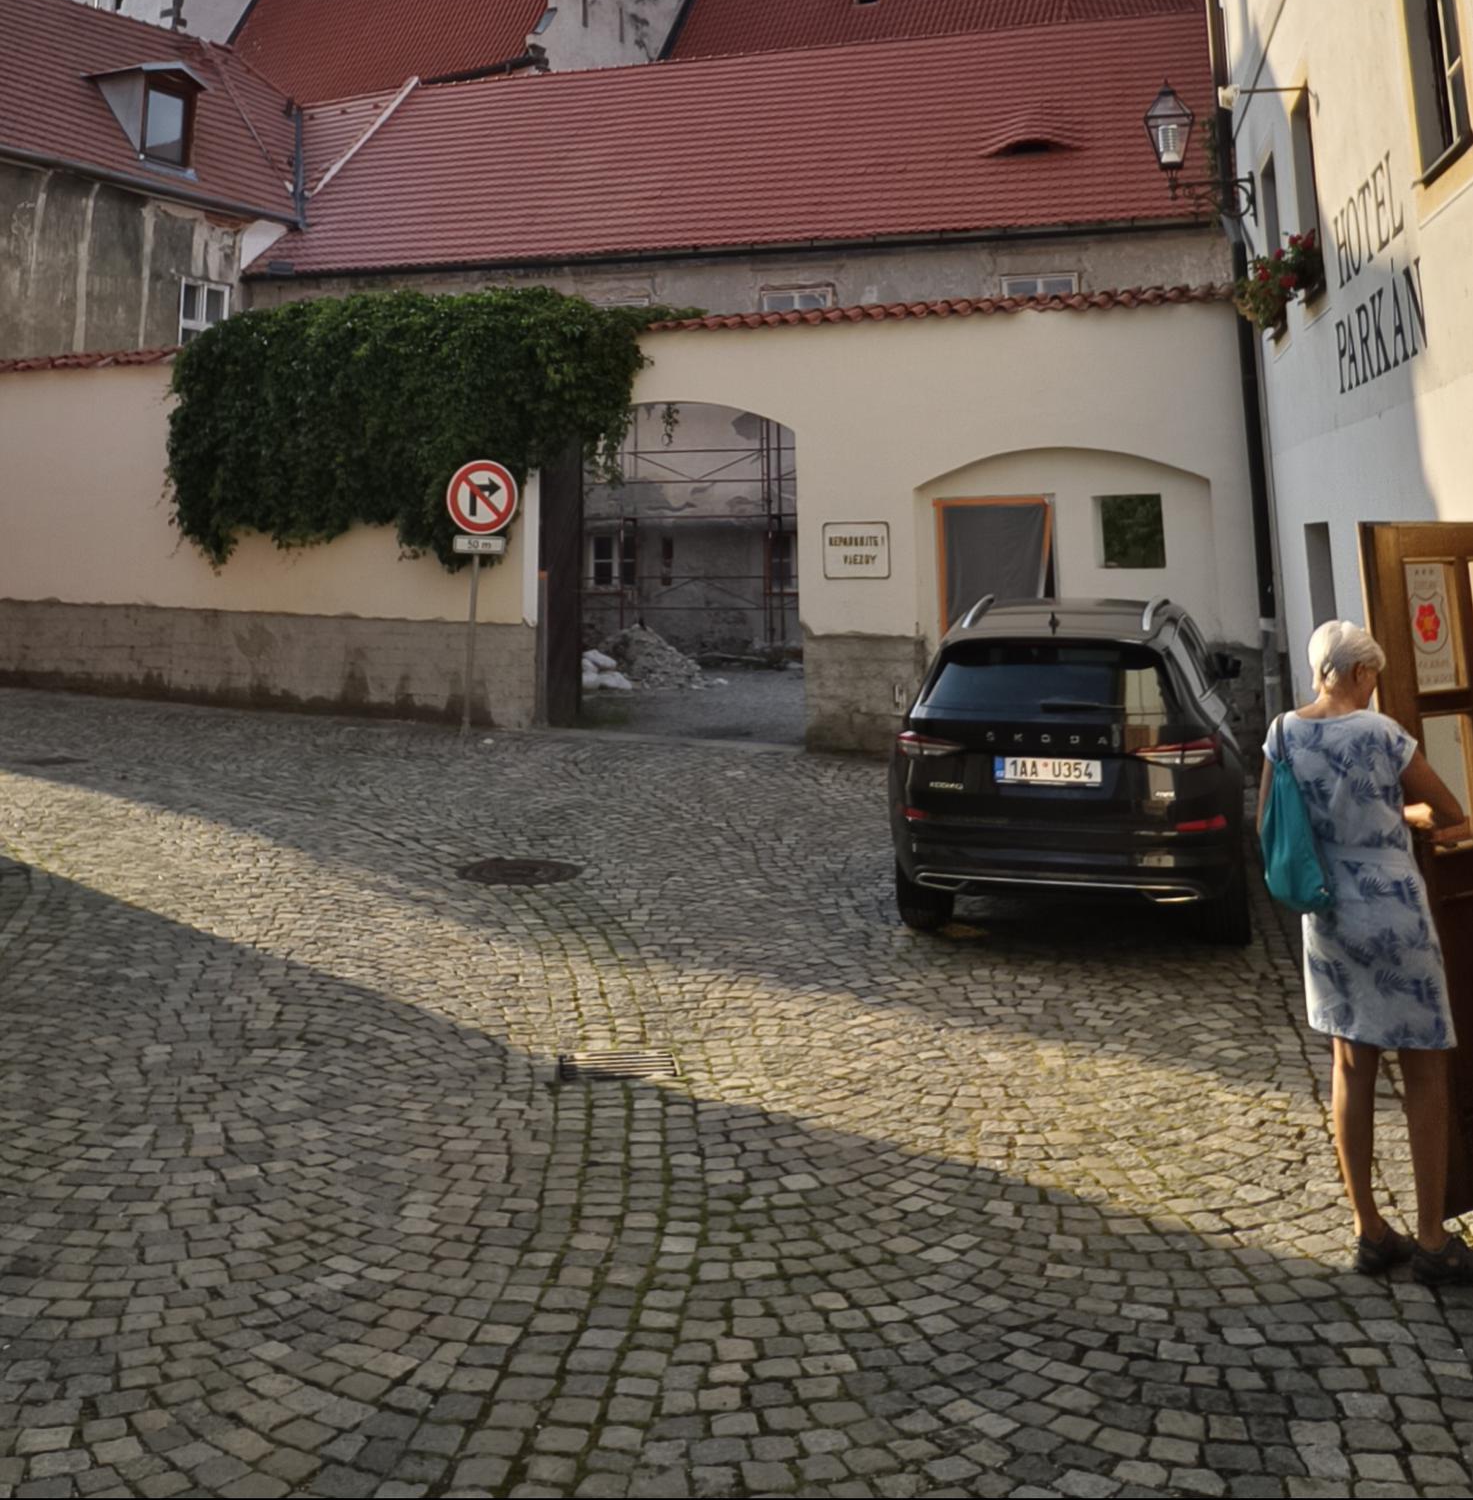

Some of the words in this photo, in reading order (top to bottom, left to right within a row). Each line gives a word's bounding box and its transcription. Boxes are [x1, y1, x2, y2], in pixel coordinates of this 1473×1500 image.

[1333, 149, 1404, 289] HOTEL
[1335, 256, 1428, 395] PARKÁN
[467, 539, 480, 549] 50
[481, 541, 492, 549] m
[1009, 759, 1039, 778] 1AA
[1052, 761, 1093, 779] U354
